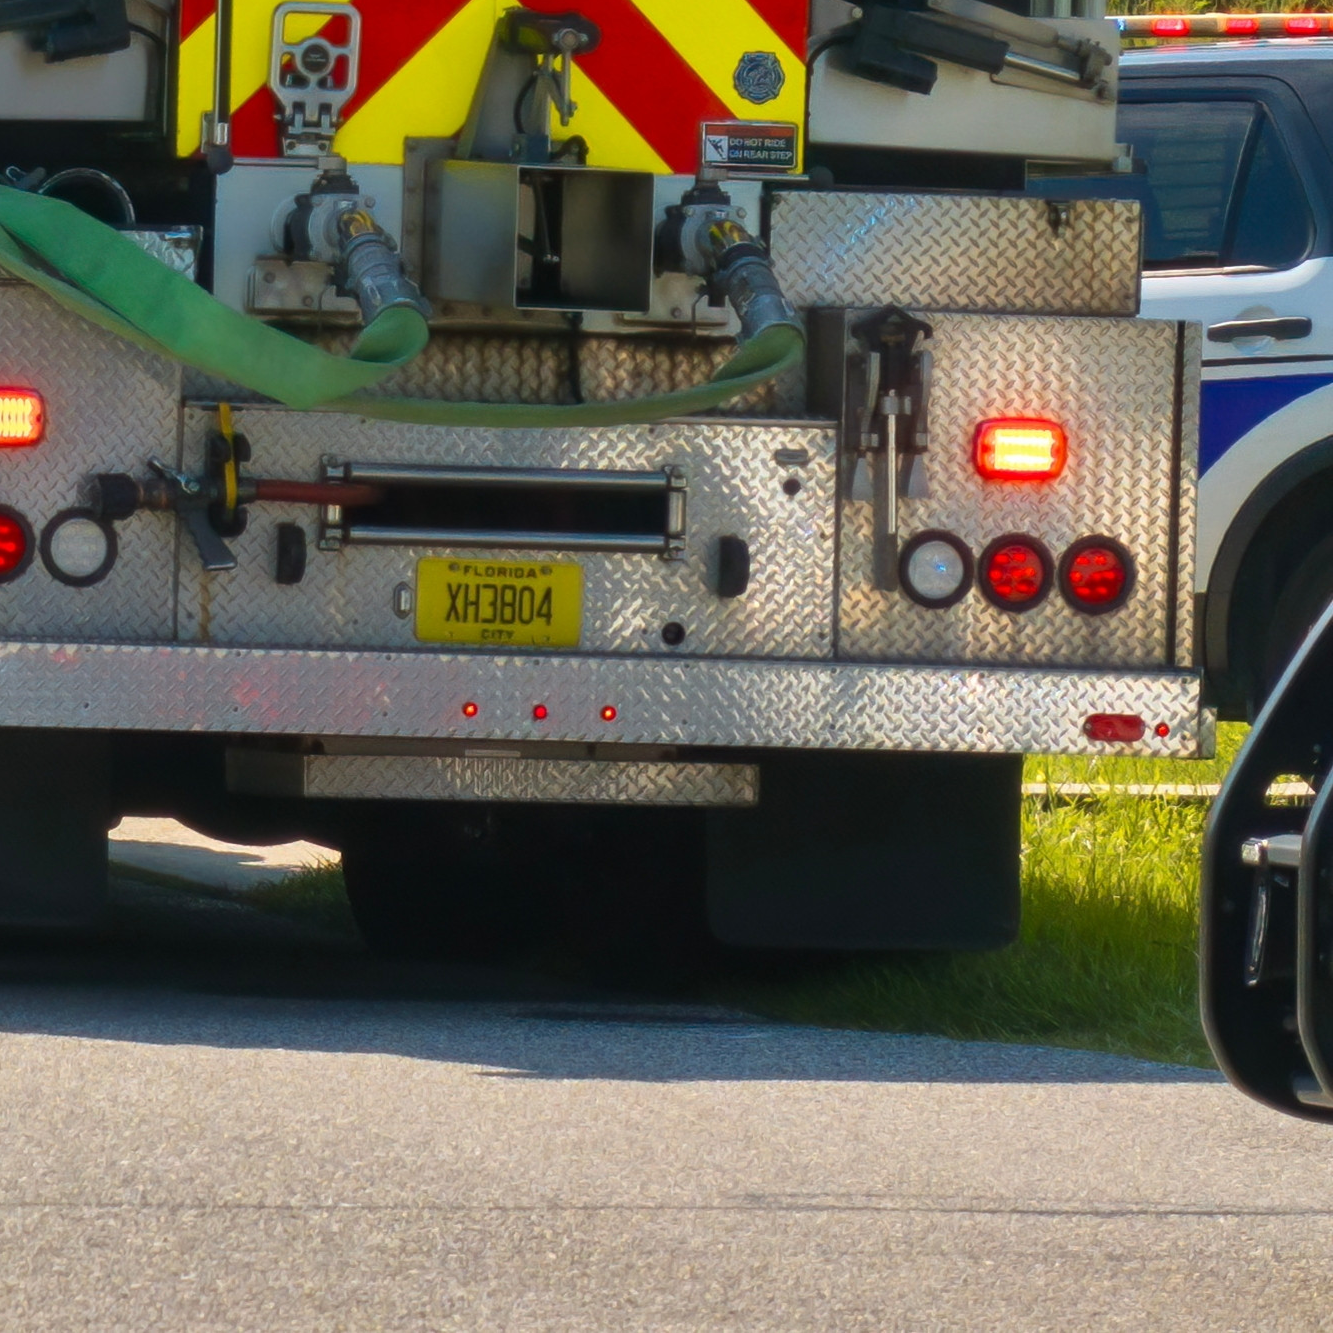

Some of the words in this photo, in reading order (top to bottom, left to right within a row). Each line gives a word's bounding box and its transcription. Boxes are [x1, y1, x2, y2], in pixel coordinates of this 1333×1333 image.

[729, 138, 743, 146] DO
[765, 139, 787, 148] RIDE
[744, 150, 769, 159] REAR
[770, 151, 792, 160] STEP
[463, 565, 538, 579] FLORIDA
[481, 628, 516, 640] CITY
